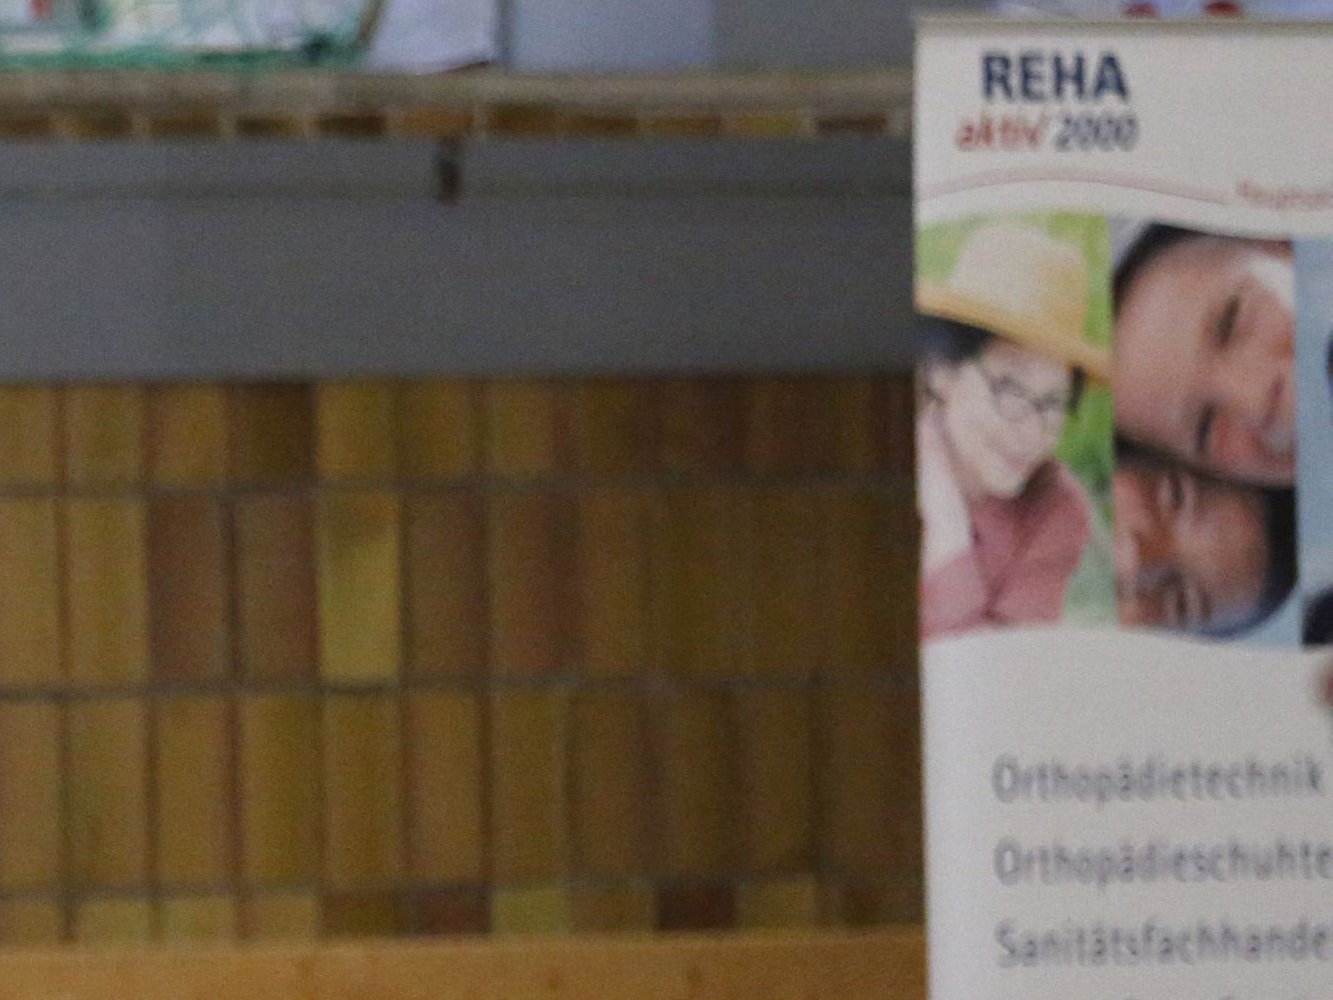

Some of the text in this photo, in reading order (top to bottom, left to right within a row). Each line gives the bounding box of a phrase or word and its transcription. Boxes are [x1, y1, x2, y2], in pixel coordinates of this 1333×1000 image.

[981, 51, 1130, 103] REHA
[1054, 109, 1142, 152] 2000
[991, 752, 1325, 808] Orthopädietechnik
